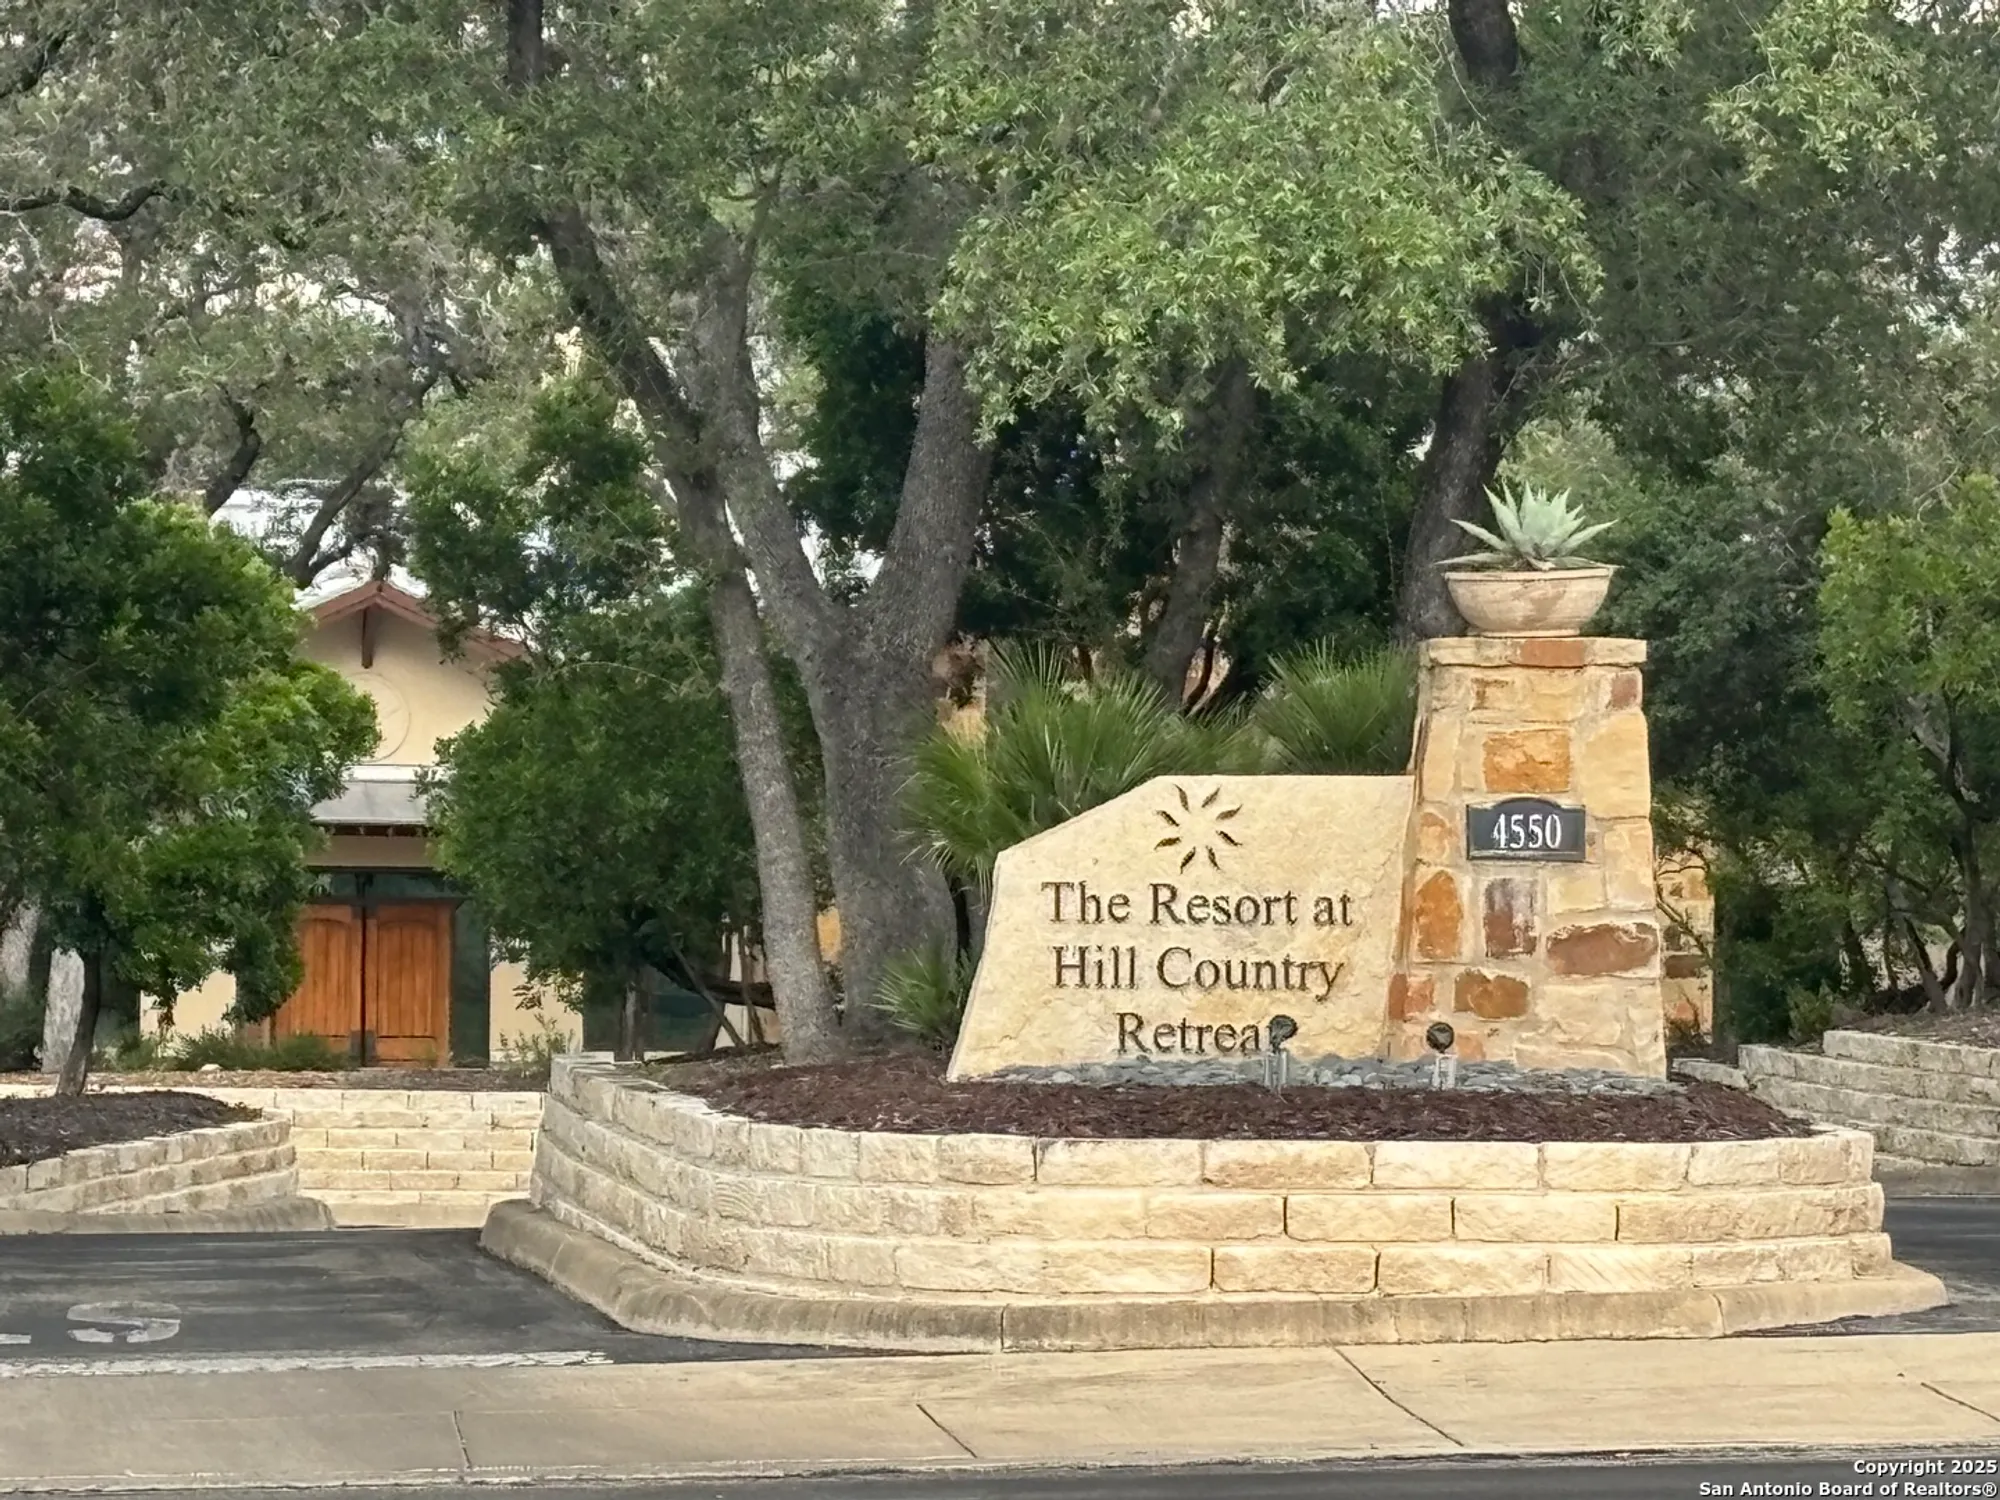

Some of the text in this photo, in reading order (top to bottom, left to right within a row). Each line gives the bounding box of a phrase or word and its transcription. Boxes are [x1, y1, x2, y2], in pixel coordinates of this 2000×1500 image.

[1491, 813, 1562, 849] 4550
[1041, 881, 1353, 926] The Resort at
[1053, 945, 1344, 1001] Hill Country
[1116, 1011, 1280, 1055] Retrea
